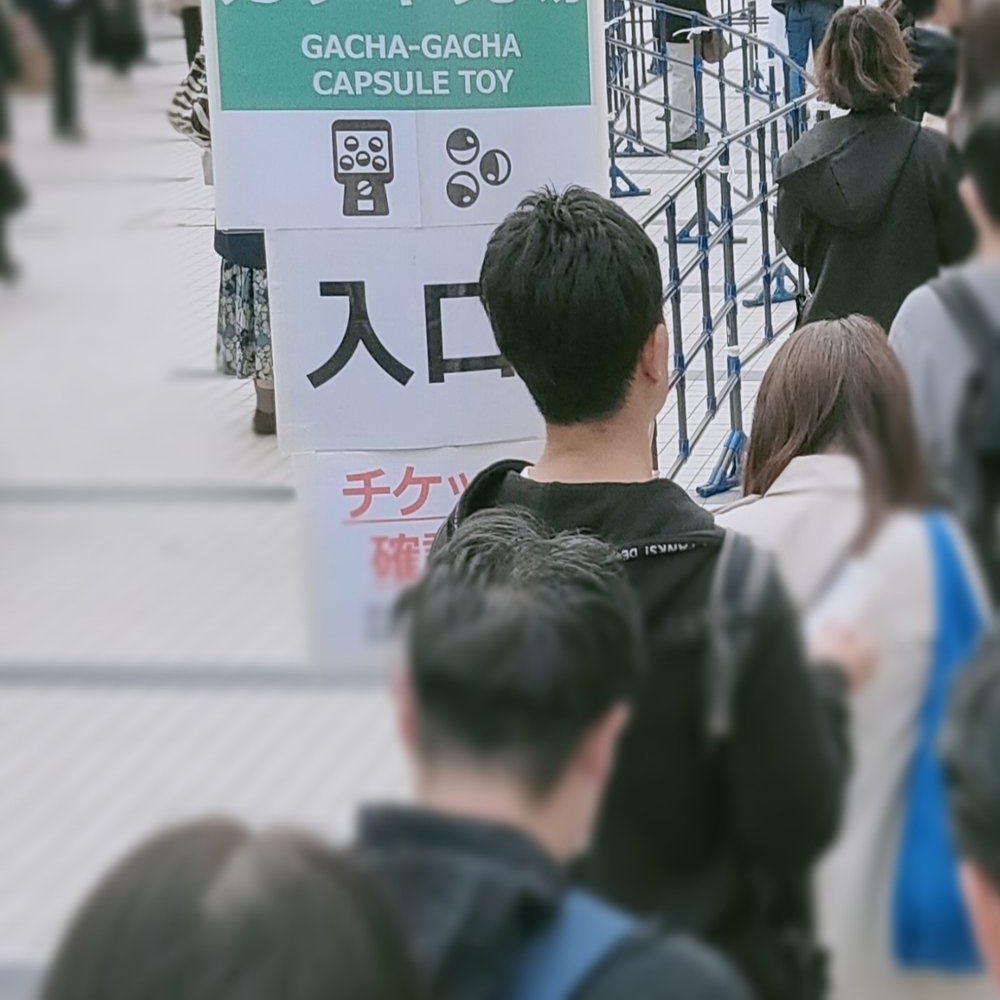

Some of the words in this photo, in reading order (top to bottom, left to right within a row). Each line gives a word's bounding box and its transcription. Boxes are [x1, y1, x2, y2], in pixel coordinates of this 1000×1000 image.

[301, 33, 521, 60] GACHA-GACHA
[312, 70, 450, 96] CAPSULE
[458, 69, 515, 94] TOY
[306, 280, 515, 389] 入口
[370, 532, 436, 584] 確
